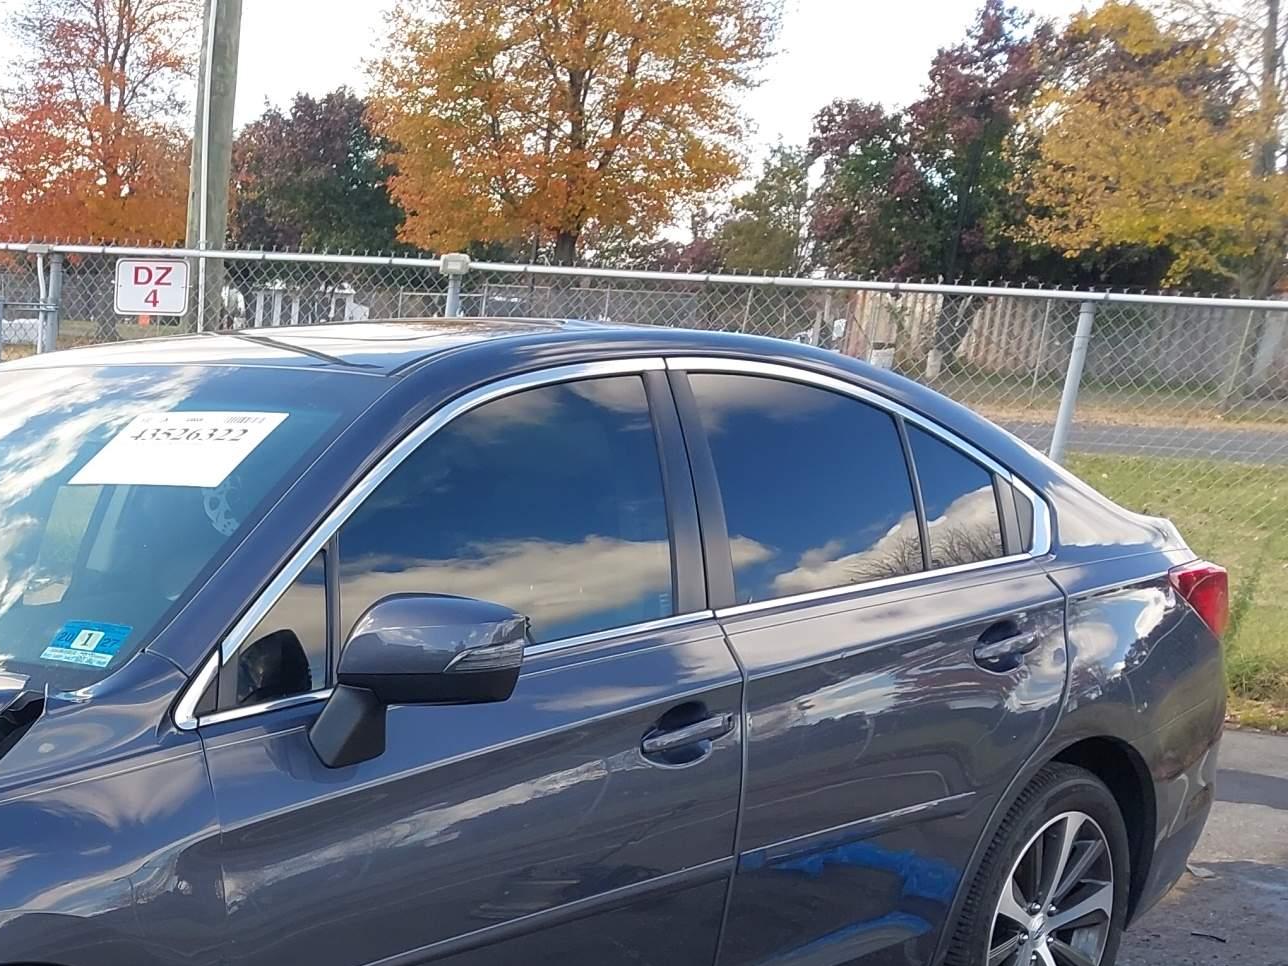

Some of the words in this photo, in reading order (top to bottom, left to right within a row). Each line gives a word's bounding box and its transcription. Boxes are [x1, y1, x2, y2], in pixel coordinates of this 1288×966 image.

[134, 266, 173, 286] DZ
[144, 288, 160, 308] 4
[79, 632, 94, 647] 1
